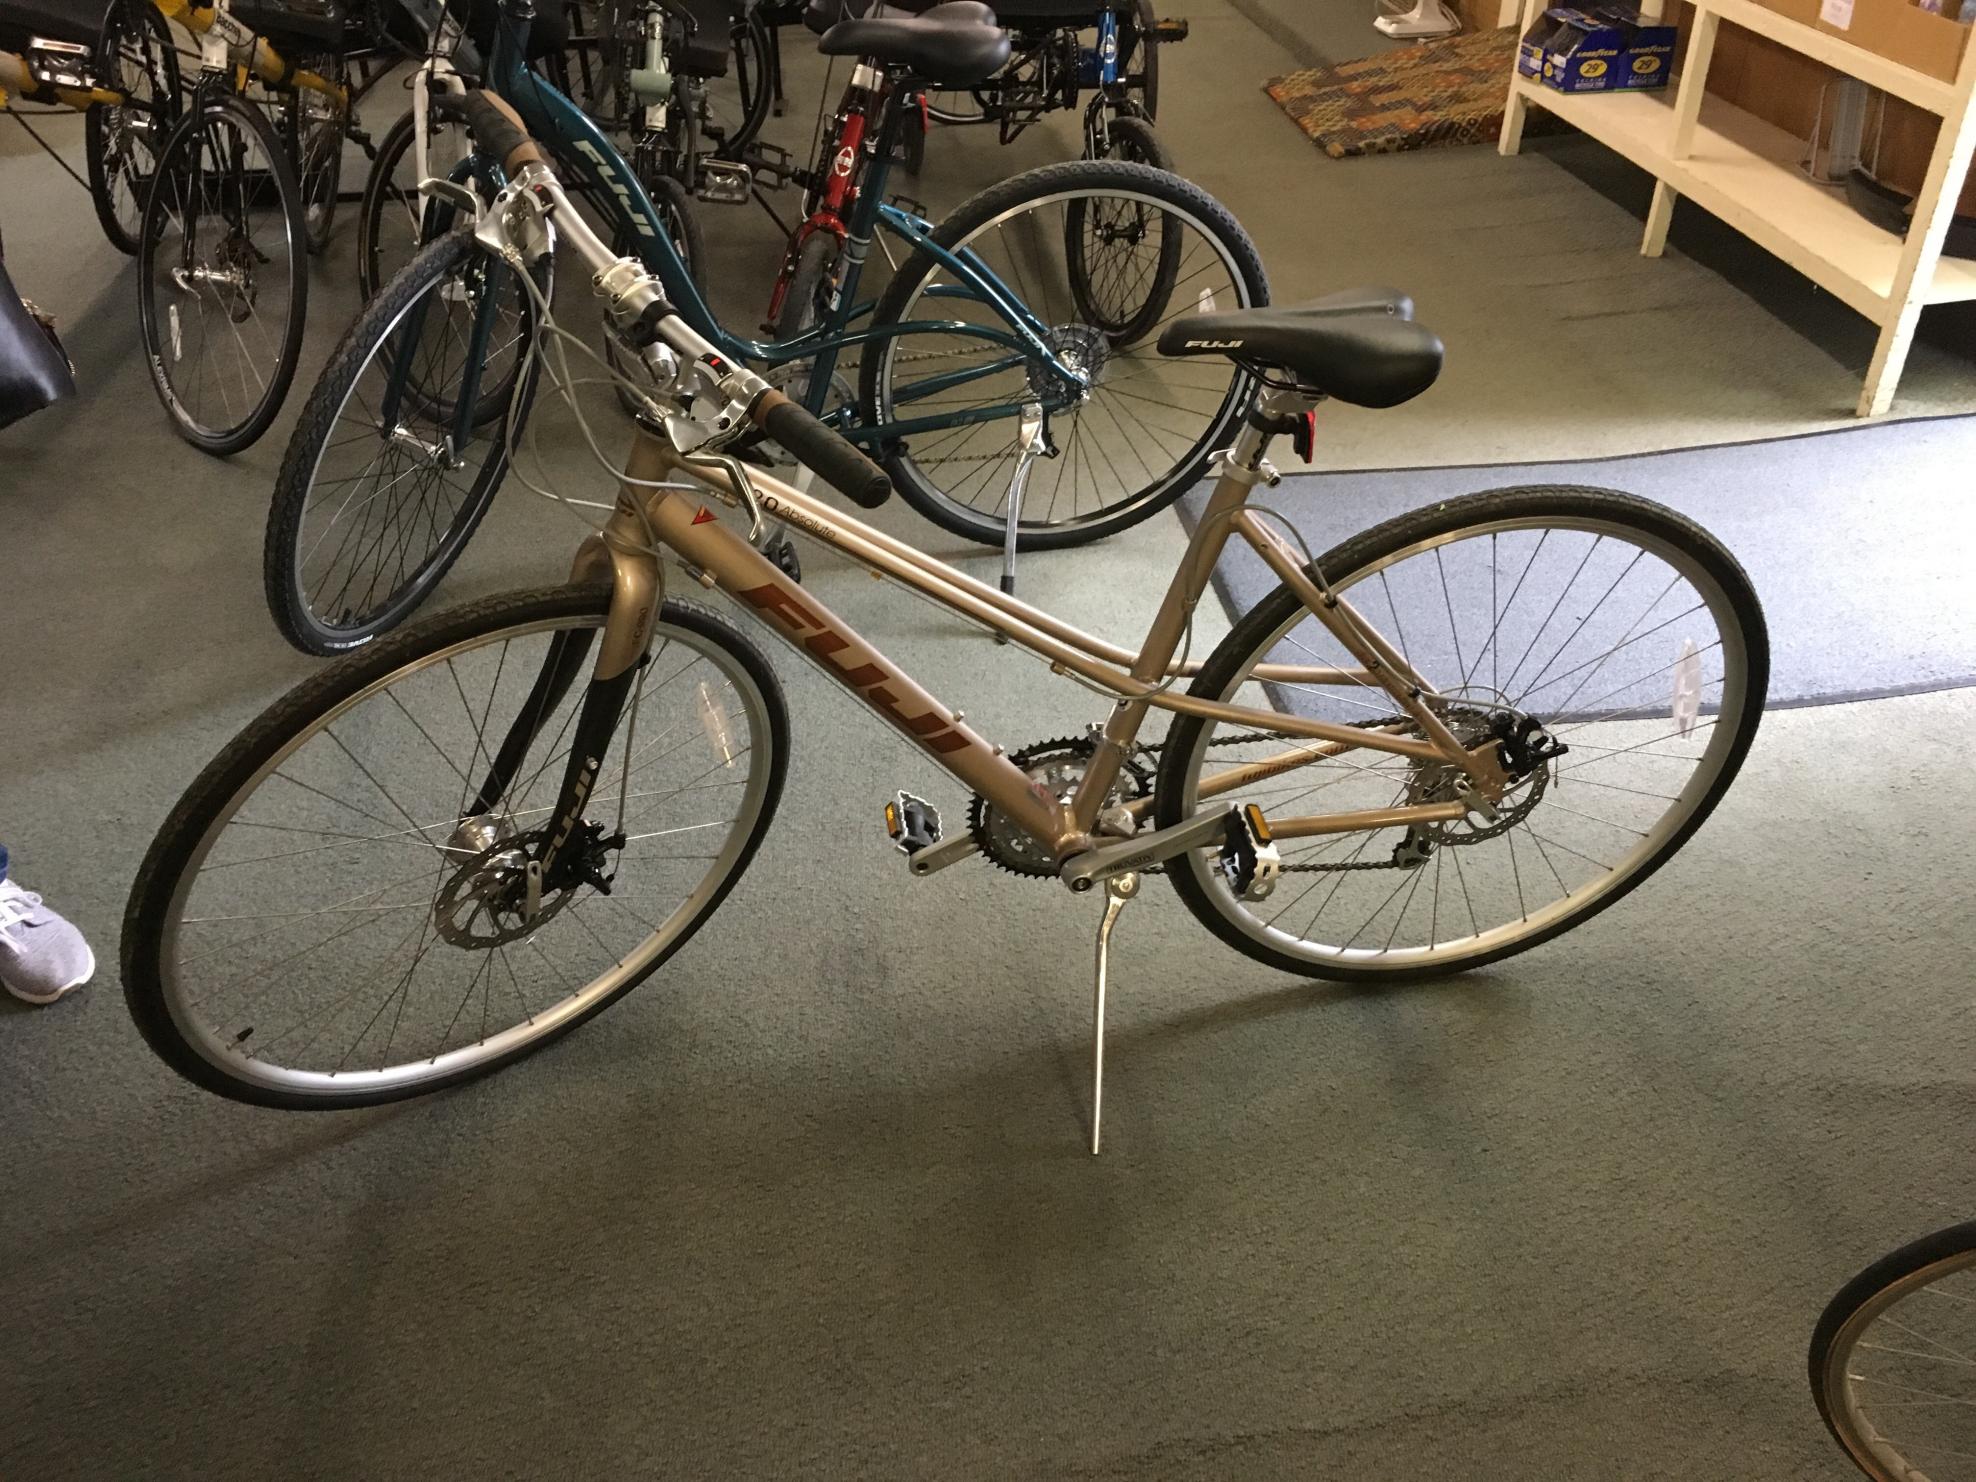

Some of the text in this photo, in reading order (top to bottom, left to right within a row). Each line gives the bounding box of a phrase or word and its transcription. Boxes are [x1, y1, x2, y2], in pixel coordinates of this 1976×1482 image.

[572, 140, 656, 236] FUJI
[1185, 340, 1243, 348] FUJI
[779, 506, 836, 539] Absolute
[737, 583, 973, 755] FUJI
[542, 769, 591, 873] FUJI
